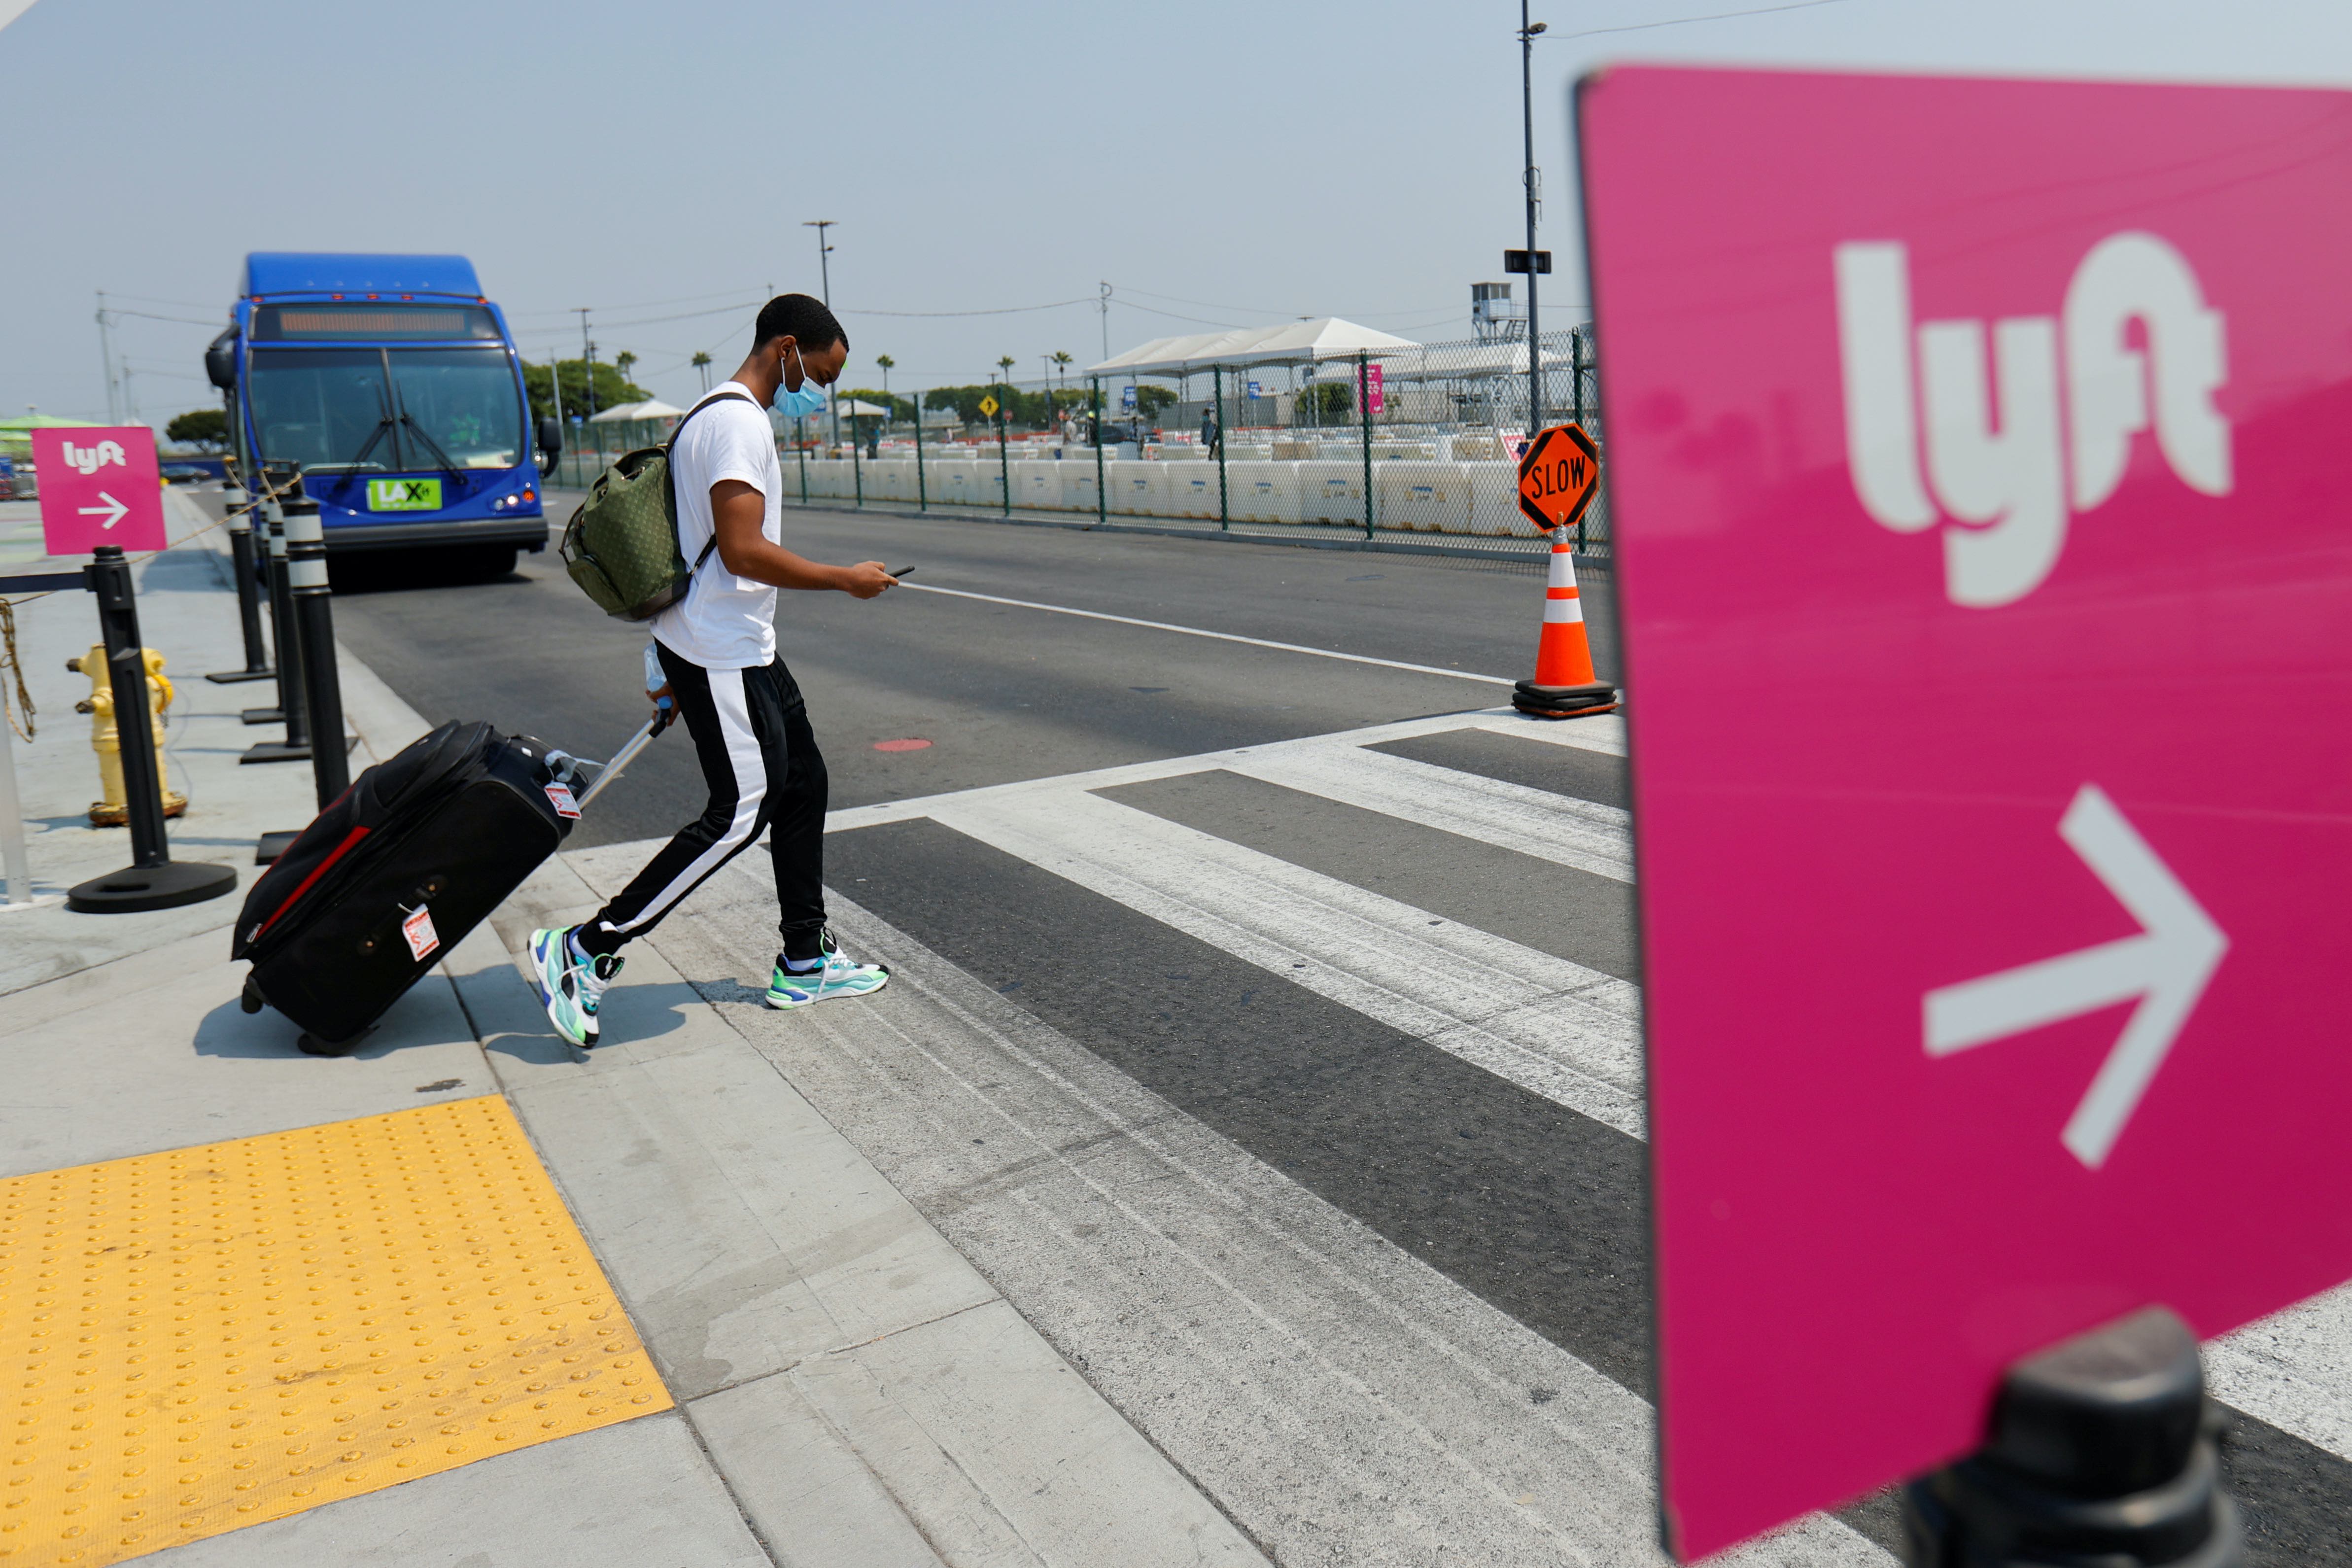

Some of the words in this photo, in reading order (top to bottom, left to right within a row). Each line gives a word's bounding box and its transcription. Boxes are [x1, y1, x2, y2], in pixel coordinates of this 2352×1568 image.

[1835, 233, 2229, 606] lyft
[63, 440, 126, 475] lyft
[1531, 454, 1586, 499] SLOW
